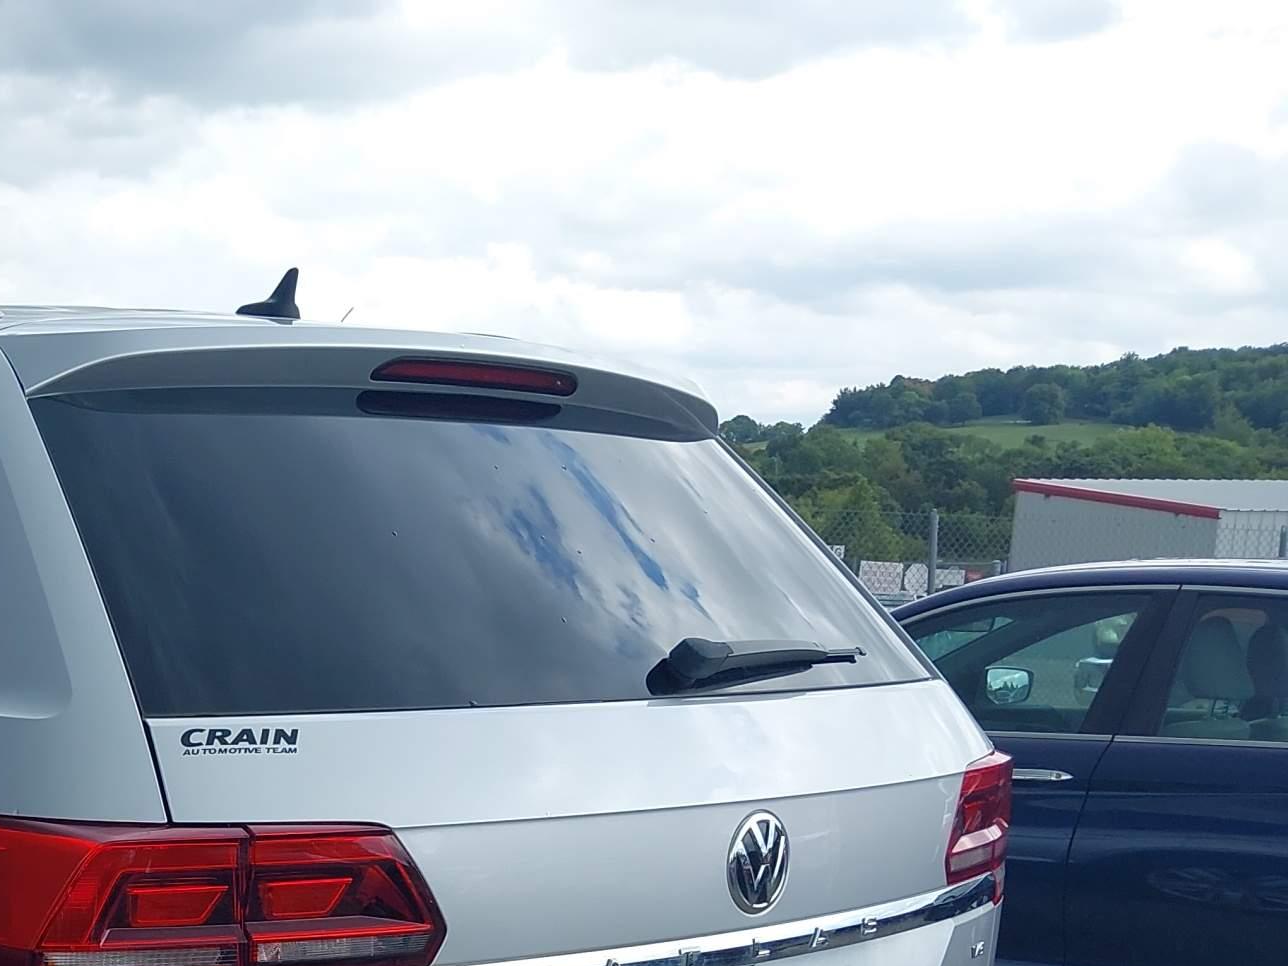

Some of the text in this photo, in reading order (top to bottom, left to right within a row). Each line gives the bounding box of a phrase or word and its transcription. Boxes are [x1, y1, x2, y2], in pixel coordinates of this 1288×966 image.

[180, 728, 299, 746] CRAIN
[183, 746, 298, 756] AUTOMOTIVE TEAM
